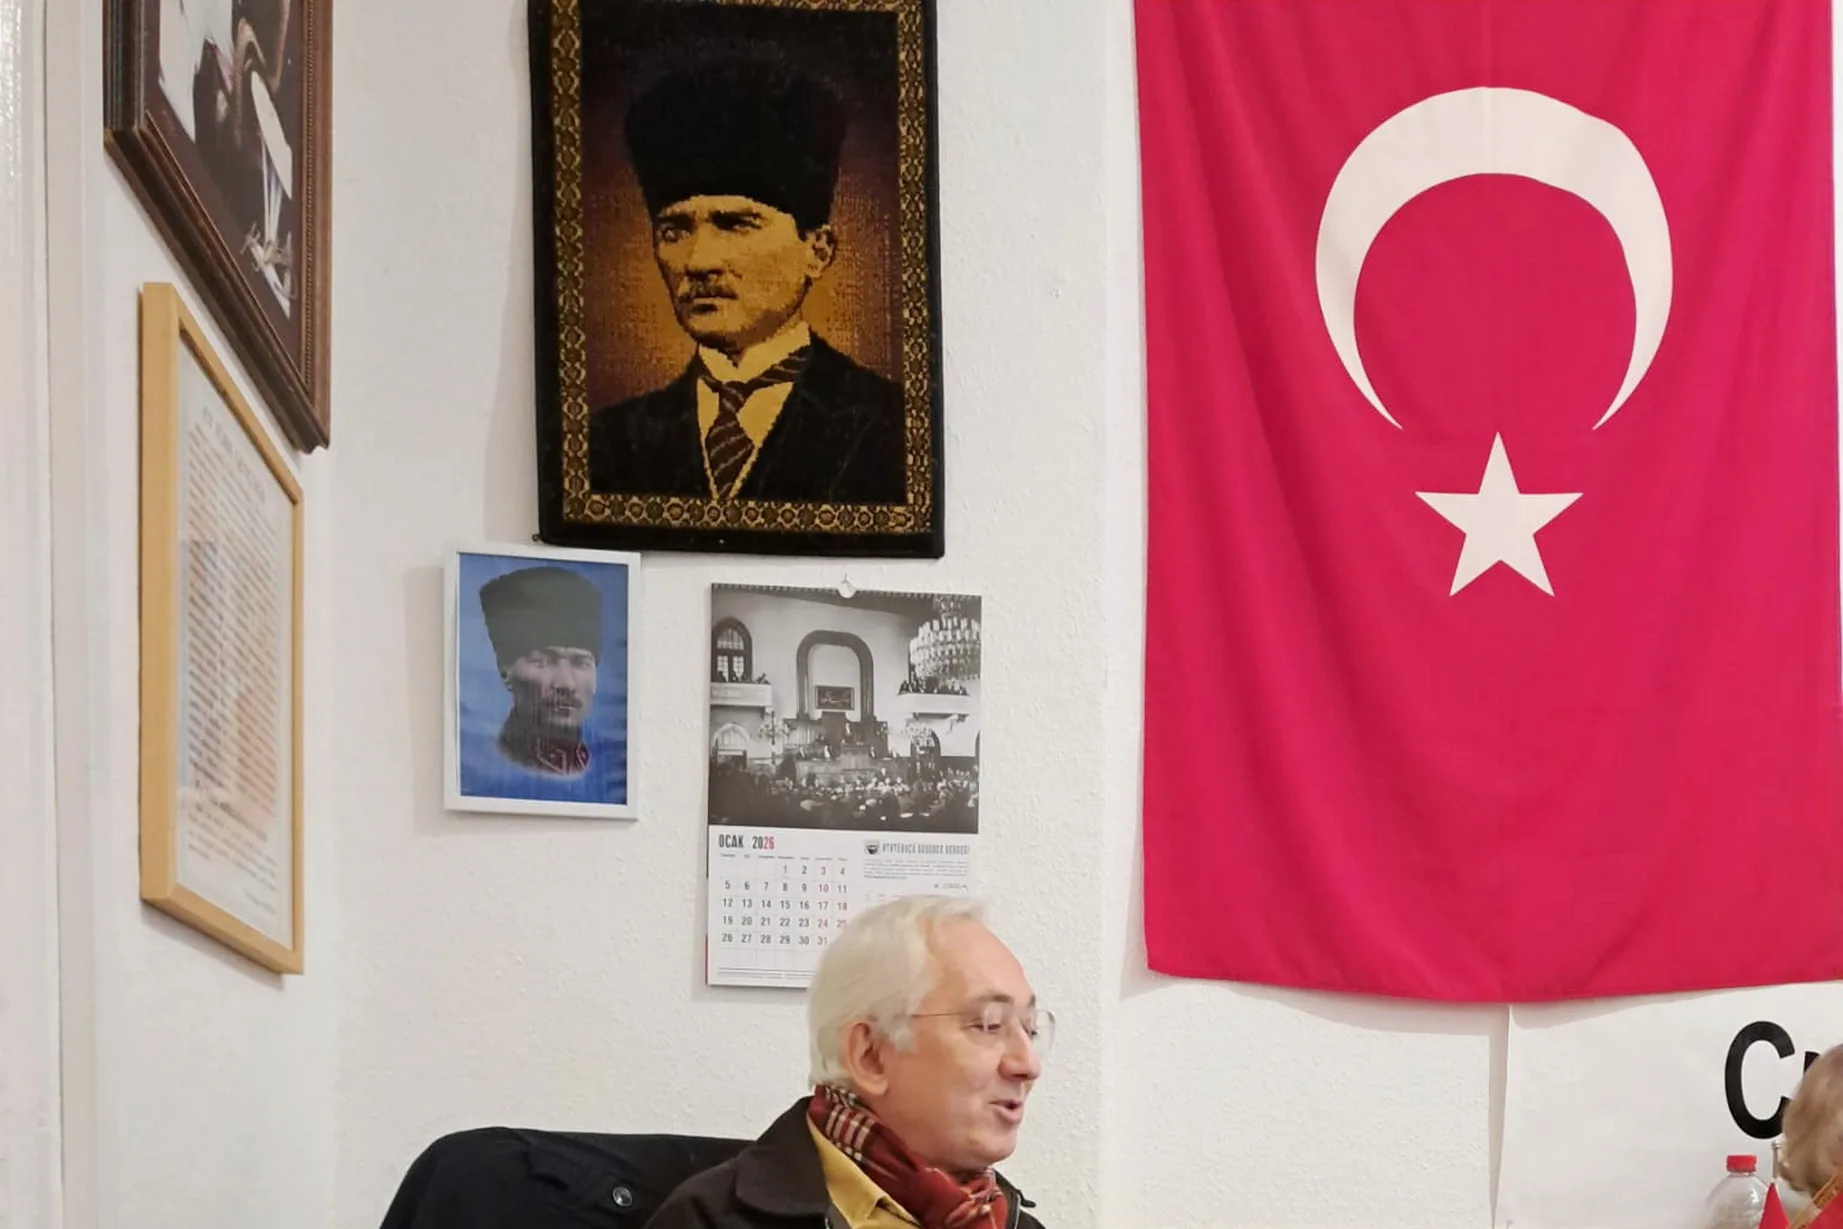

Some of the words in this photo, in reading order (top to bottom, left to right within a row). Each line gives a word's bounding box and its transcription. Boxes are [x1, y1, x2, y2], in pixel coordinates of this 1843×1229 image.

[719, 834, 743, 848] OCAK
[752, 836, 774, 849] 2026
[782, 865, 788, 874] 1
[801, 865, 808, 874] 2
[820, 866, 827, 875] 3
[839, 867, 846, 875] 4
[724, 881, 731, 889] 5
[744, 882, 750, 890] 6
[763, 882, 769, 890] 7
[782, 883, 788, 891] 8
[801, 883, 808, 892] 9
[818, 884, 828, 892] 10
[838, 885, 847, 893] 11
[723, 898, 732, 907] 12
[743, 899, 752, 908] 13
[761, 900, 771, 908] 14
[781, 901, 790, 909] 15
[800, 901, 809, 910] 16
[818, 902, 828, 910] 17
[723, 916, 733, 924] 19
[742, 917, 752, 925] 20
[761, 917, 770, 926] 21
[780, 918, 790, 926] 22
[799, 919, 809, 927] 23
[818, 919, 828, 928] 24
[722, 933, 732, 942] 26
[741, 934, 751, 942] 27
[761, 934, 771, 944] 28
[780, 935, 790, 944] 29
[799, 936, 809, 945] 30
[818, 936, 827, 945] 31
[1725, 1020, 1821, 1140] C
